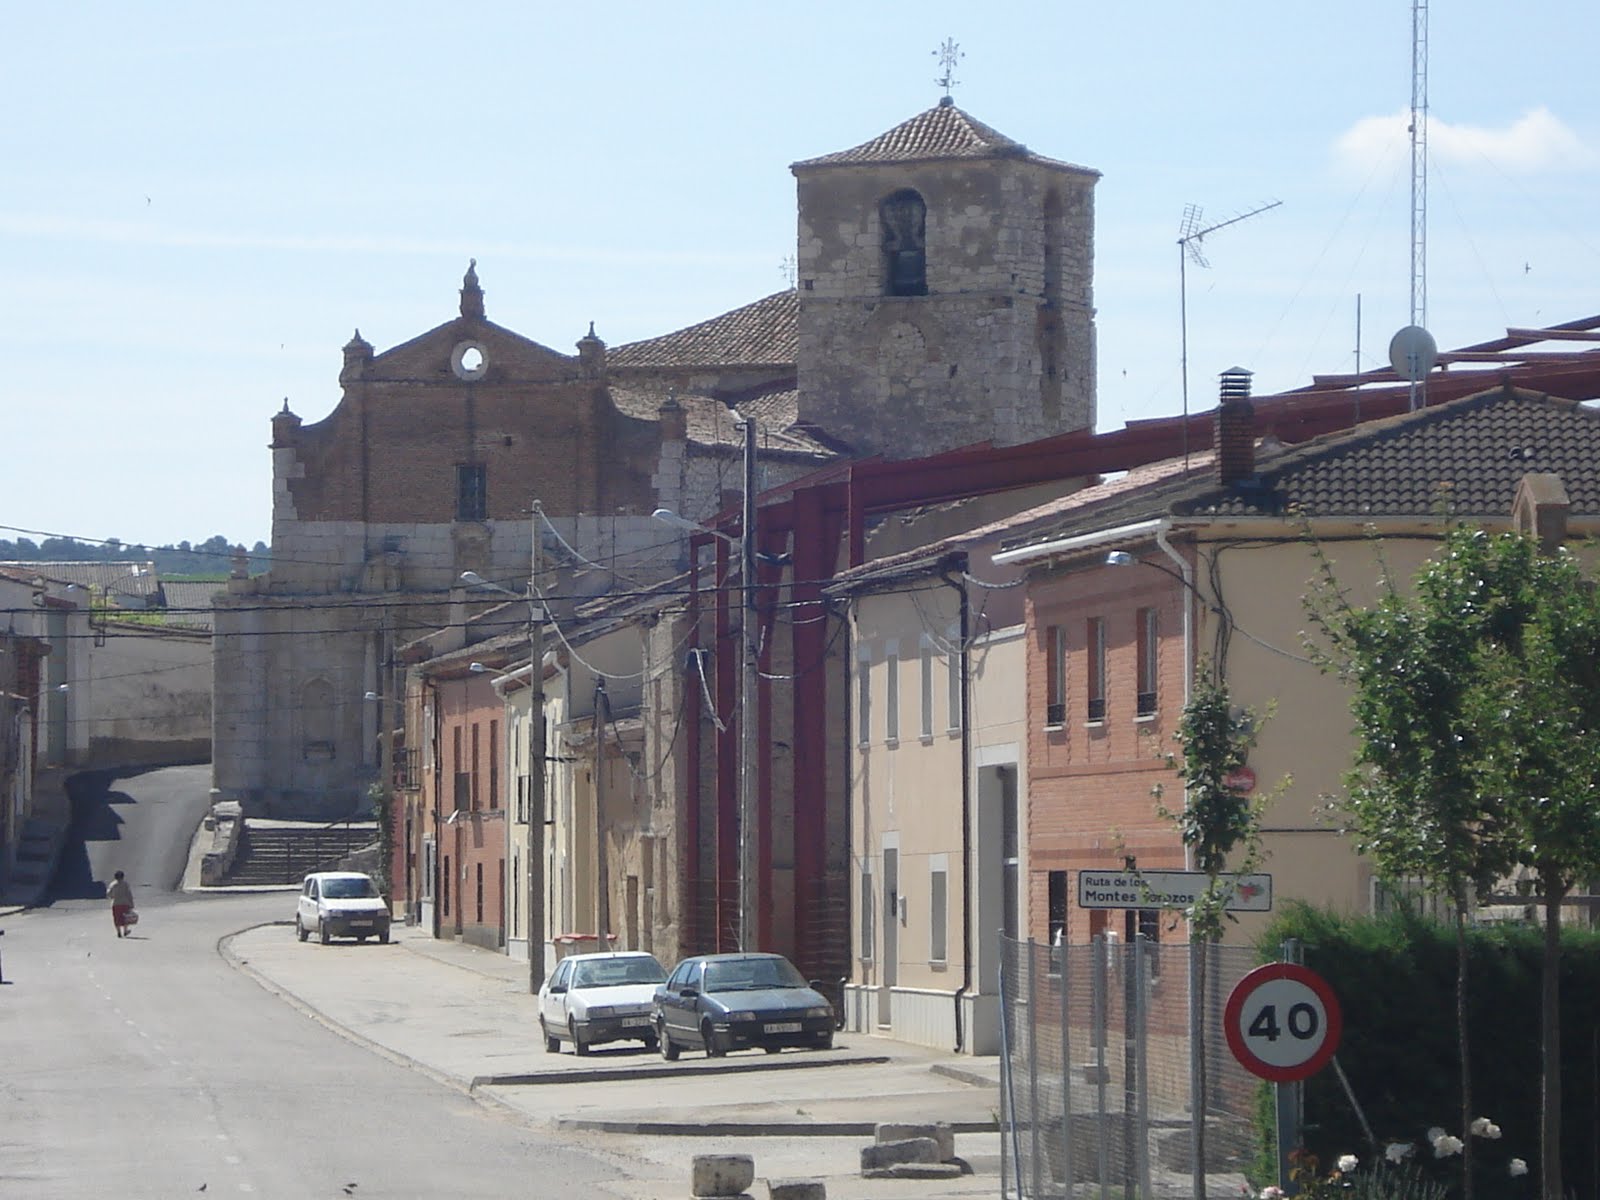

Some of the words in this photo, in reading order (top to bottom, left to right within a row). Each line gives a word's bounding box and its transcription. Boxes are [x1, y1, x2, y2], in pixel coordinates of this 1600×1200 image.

[1085, 877, 1110, 886] Ruta
[1114, 877, 1127, 887] de
[1085, 890, 1136, 902] Montes
[1142, 891, 1195, 903] orozos
[1248, 1002, 1319, 1042] 40
